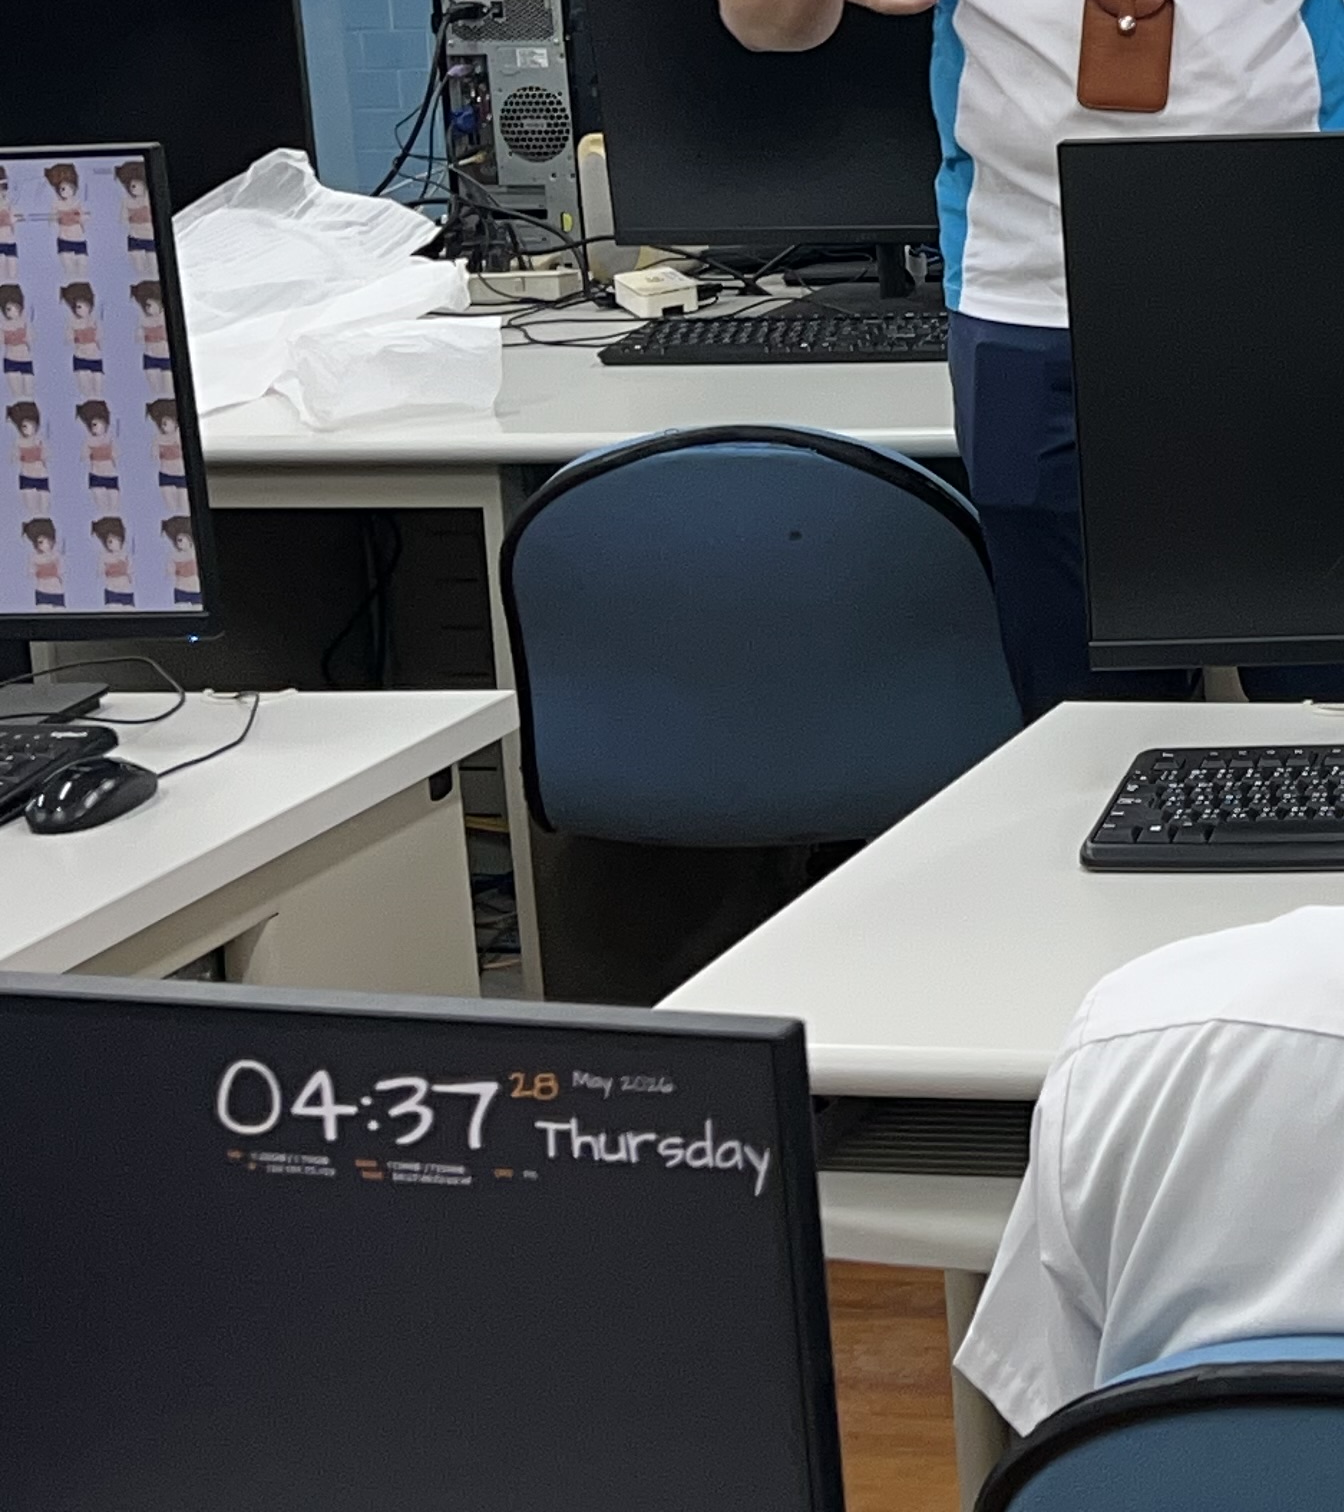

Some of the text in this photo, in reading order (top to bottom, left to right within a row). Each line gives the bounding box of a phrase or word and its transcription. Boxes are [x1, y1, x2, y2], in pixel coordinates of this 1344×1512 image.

[216, 1058, 500, 1150] 04:37
[508, 1072, 560, 1101] 28
[571, 1068, 613, 1101] May
[534, 1119, 772, 1197] Thursday
